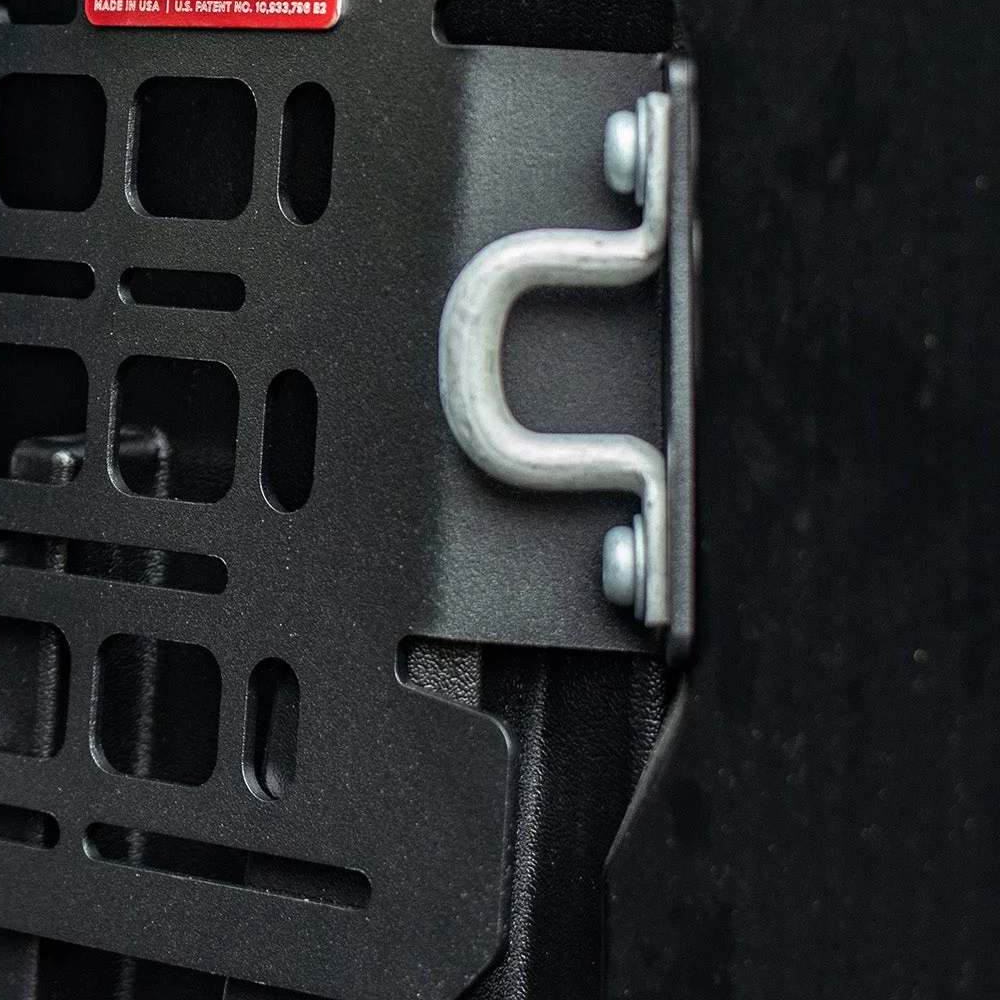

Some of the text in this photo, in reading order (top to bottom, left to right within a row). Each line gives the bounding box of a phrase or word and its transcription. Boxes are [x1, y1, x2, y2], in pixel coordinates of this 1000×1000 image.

[94, 0, 123, 12] MADE
[125, 0, 136, 12] IN
[138, 0, 160, 12] USA
[174, 0, 193, 12] U.S.
[195, 0, 232, 13] PATENT
[234, 1, 252, 13] NO.
